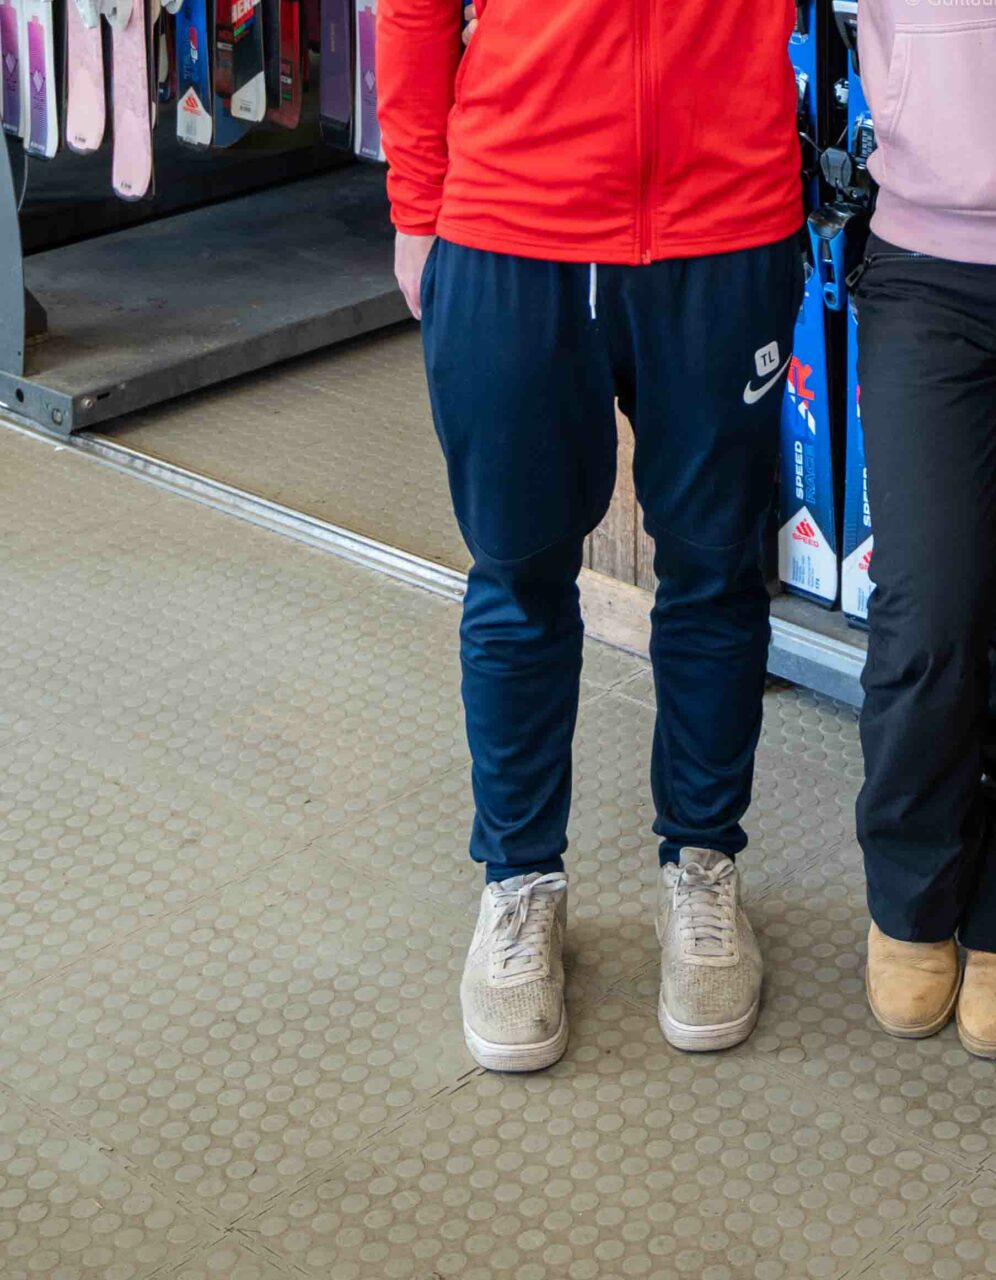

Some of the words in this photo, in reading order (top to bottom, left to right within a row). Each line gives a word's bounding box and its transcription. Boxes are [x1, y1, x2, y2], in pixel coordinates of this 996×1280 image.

[760, 350, 775, 367] TL
[795, 440, 804, 499] SPEED
[791, 532, 820, 548] SPEED
